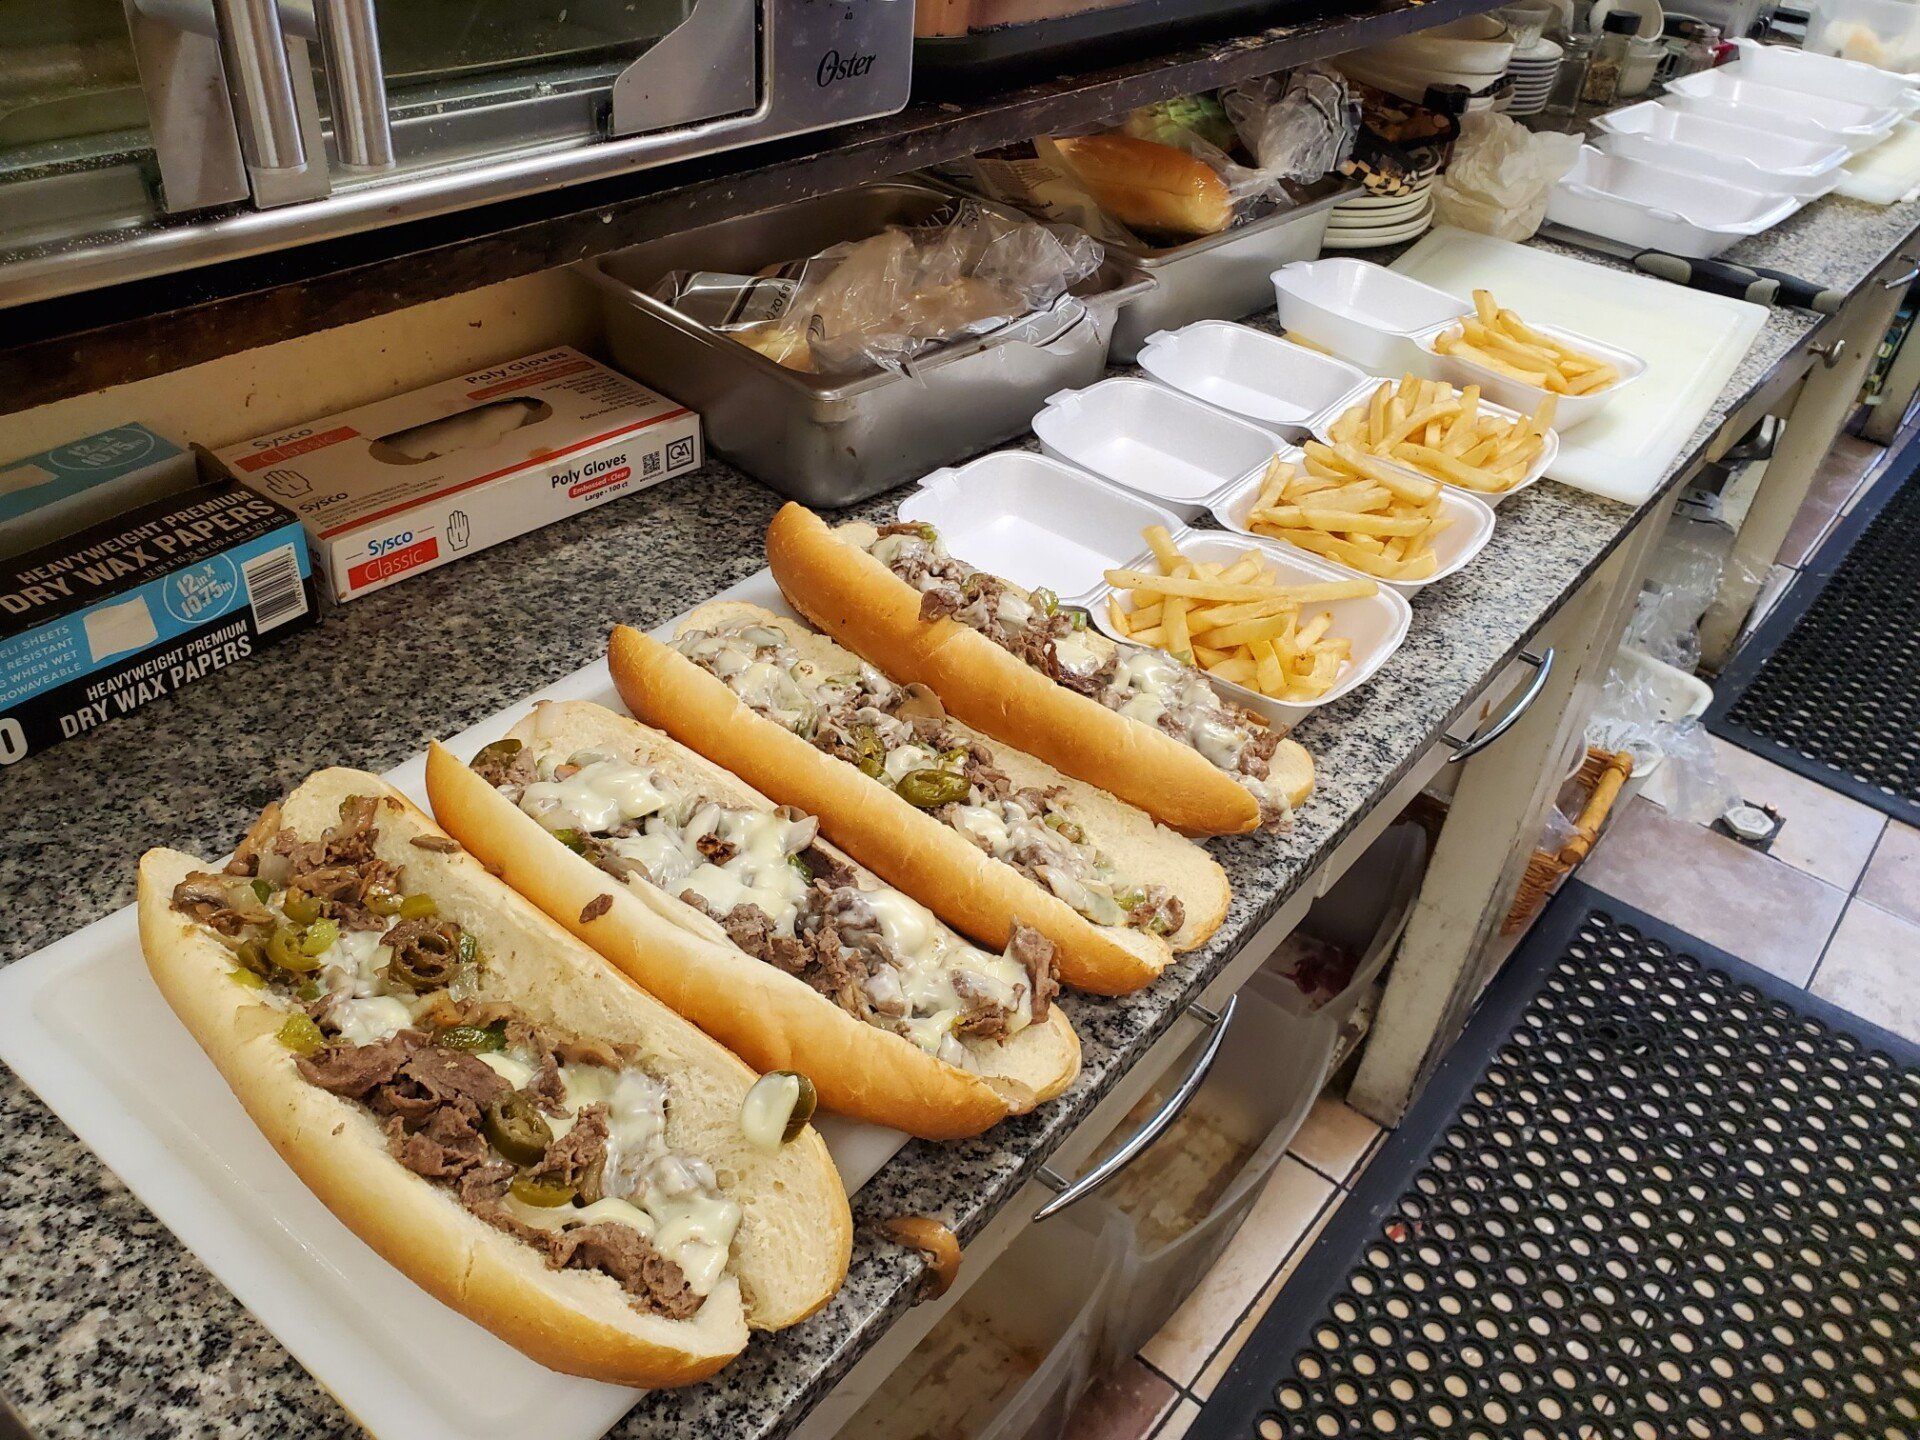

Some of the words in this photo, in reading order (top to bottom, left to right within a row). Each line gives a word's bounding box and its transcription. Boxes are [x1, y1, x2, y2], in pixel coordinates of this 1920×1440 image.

[816, 50, 877, 88] Oster
[465, 368, 508, 384] Poly
[508, 352, 569, 371] Gloves
[252, 428, 314, 449] Sysco
[551, 469, 581, 489] Poly
[583, 453, 627, 476] Gloves
[610, 470, 628, 481] Clear
[299, 492, 349, 514] Sysco
[584, 489, 604, 502] Large
[608, 484, 621, 493] 100
[16, 521, 163, 585] HEAVYWEIGHT
[162, 490, 255, 528] PREMIUM
[367, 531, 414, 556] Sysco
[0, 576, 75, 615] DRY
[72, 544, 160, 586] WAX
[151, 500, 276, 554] PAPERS
[364, 548, 425, 582] Classic
[0, 645, 19, 659] ELI
[22, 625, 70, 650] SHEETS
[6, 637, 74, 671] RESISTANT
[9, 661, 48, 682] WHEN
[51, 649, 78, 666] WET
[86, 648, 184, 702] HEAVYWEIGHT
[187, 619, 248, 658] PREMIUM
[0, 662, 82, 703] ROWAVEABLE
[59, 698, 109, 739] DRY
[113, 674, 168, 714] WAX
[170, 635, 253, 690] PAPERS
